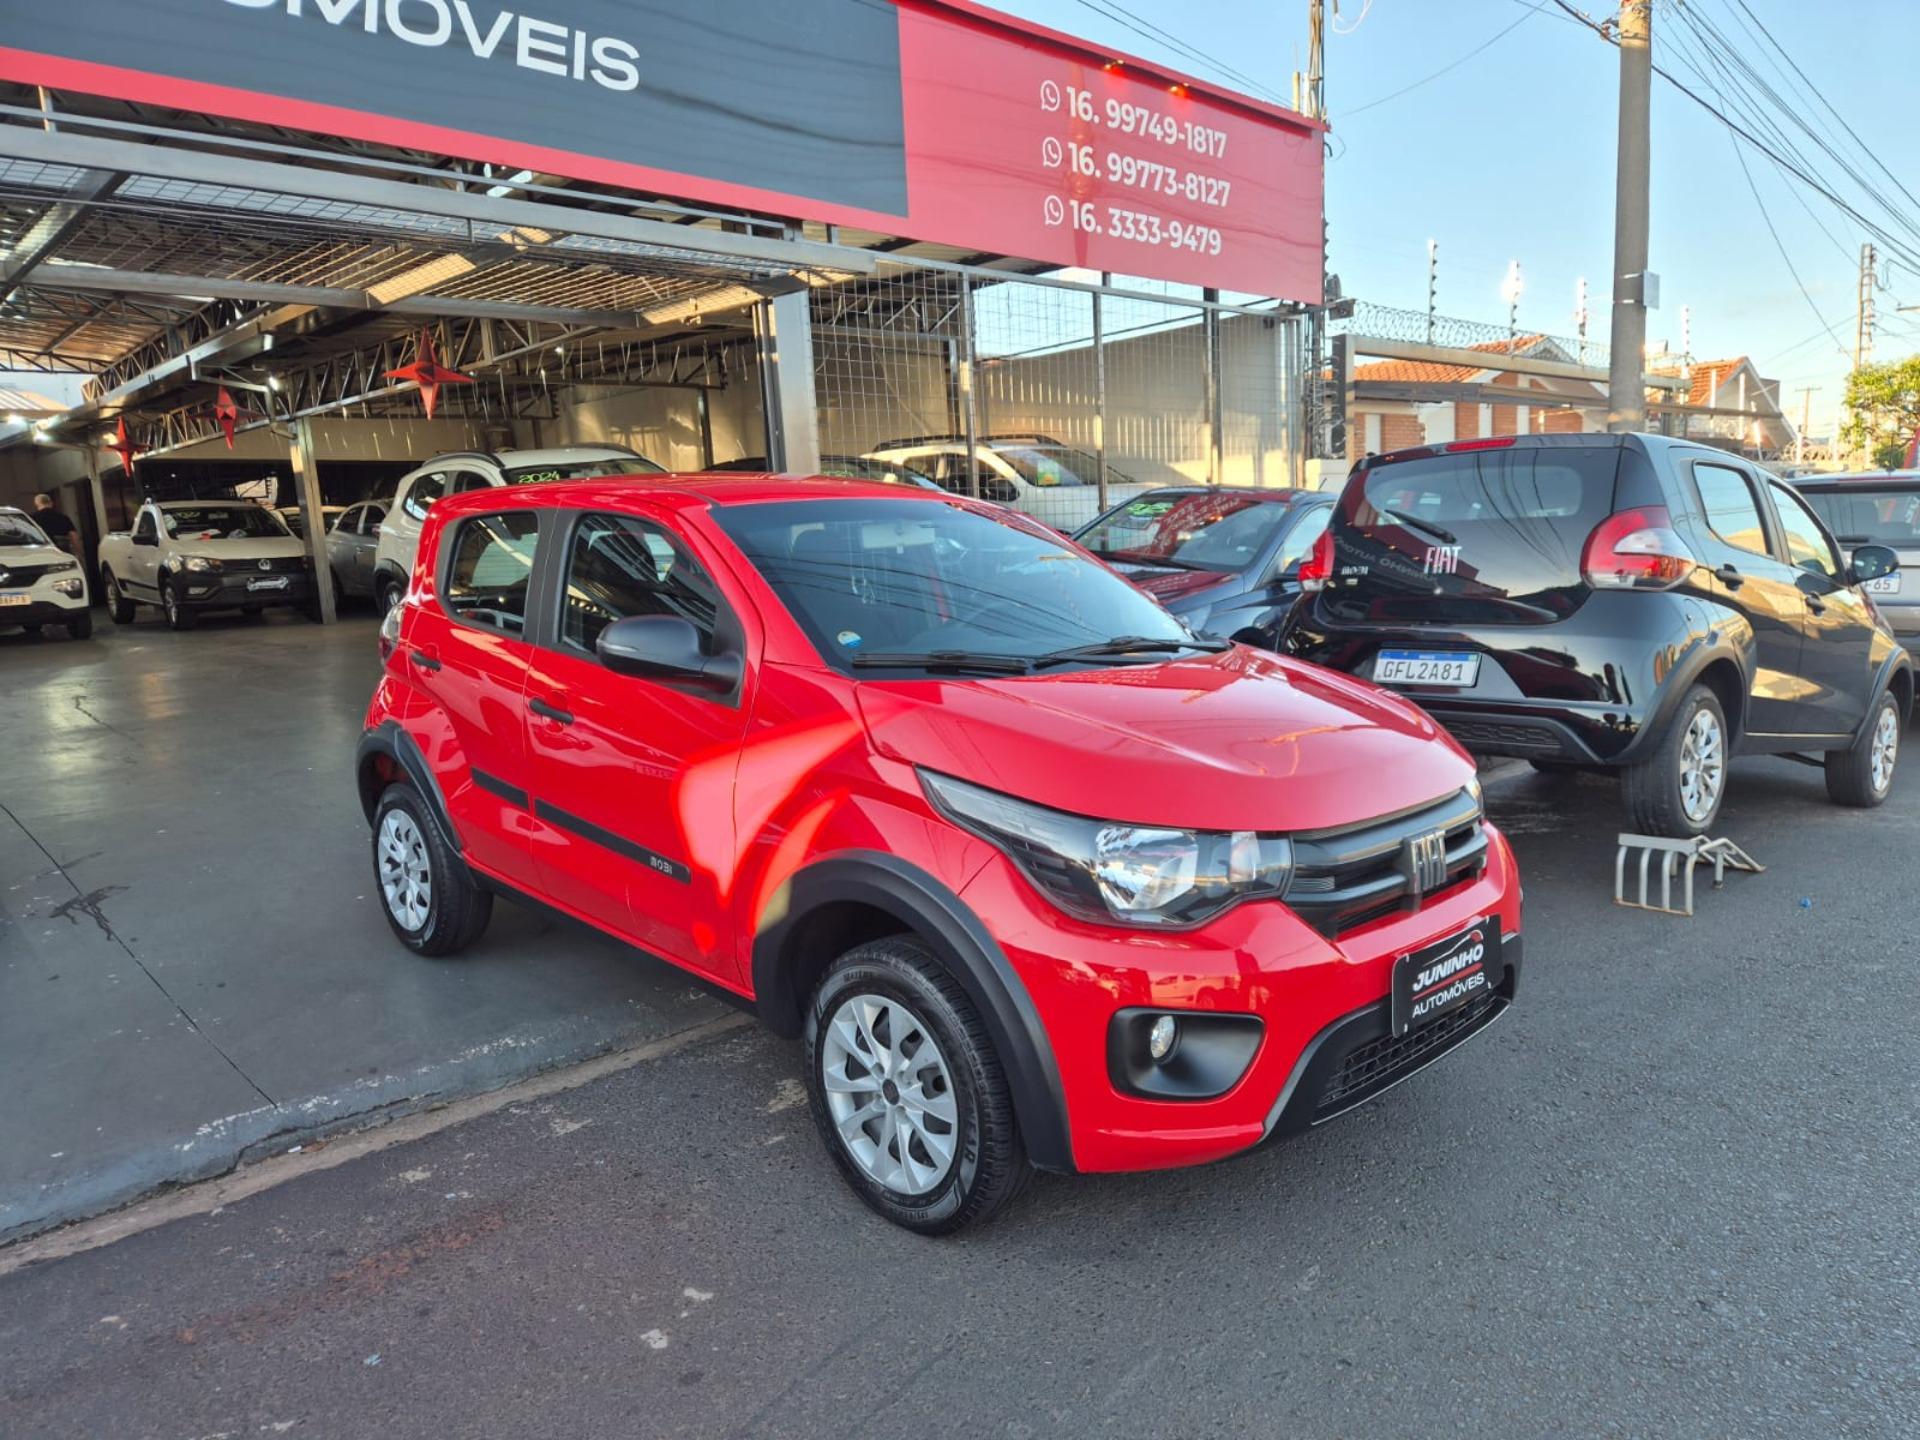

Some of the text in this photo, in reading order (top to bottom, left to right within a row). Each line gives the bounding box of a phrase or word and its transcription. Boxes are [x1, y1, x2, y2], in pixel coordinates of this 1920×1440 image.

[1066, 86, 1227, 158] 16. 99749-1817
[1068, 142, 1230, 207] 16. 99773-8127
[1070, 200, 1221, 255] 16. 3333-9479
[1423, 546, 1462, 574] FIAT
[1383, 661, 1464, 681] GFL2A81
[1412, 944, 1484, 992] JUNINHO
[1412, 972, 1485, 1018] AUTOMÓVEIS
